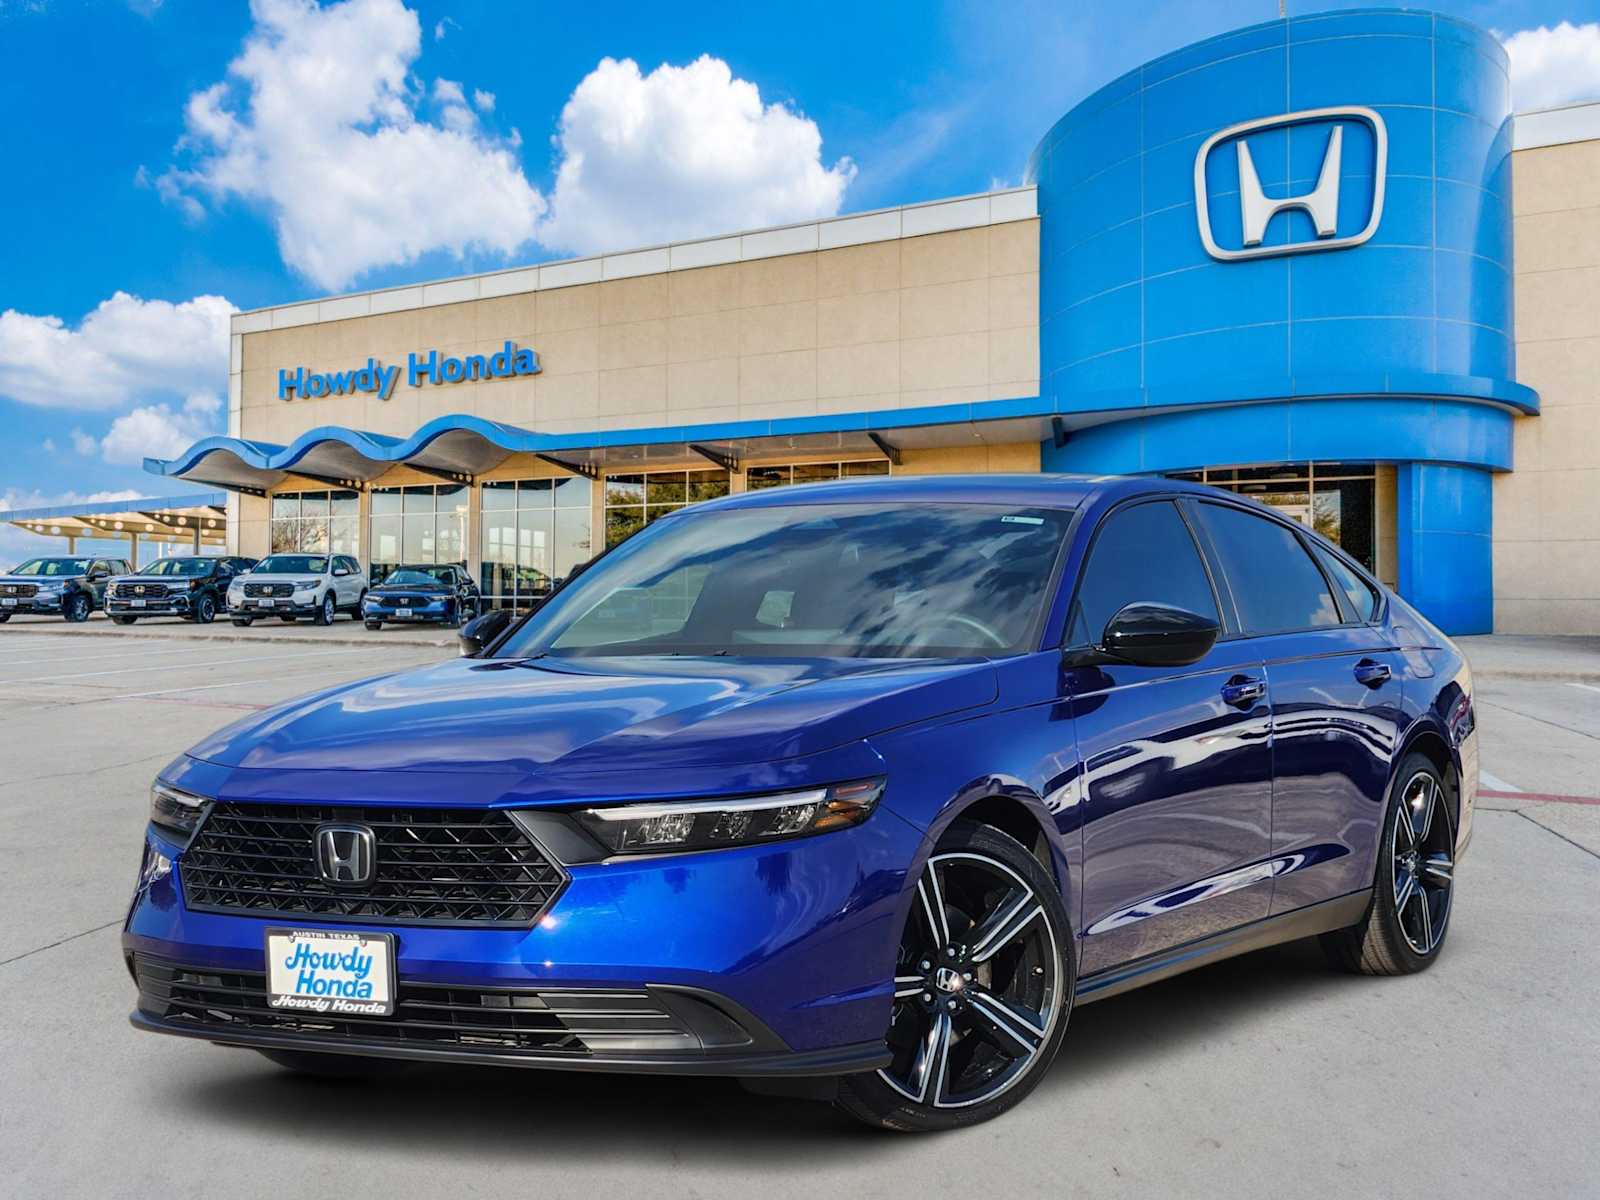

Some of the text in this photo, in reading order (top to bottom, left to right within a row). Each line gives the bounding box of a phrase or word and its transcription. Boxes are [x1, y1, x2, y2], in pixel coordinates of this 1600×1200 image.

[278, 340, 541, 400] Howdy Honda
[292, 931, 326, 939] AUSTIN
[285, 943, 373, 979] Howdy
[295, 969, 373, 999] Honda
[272, 995, 387, 1014] Howdy Honda
